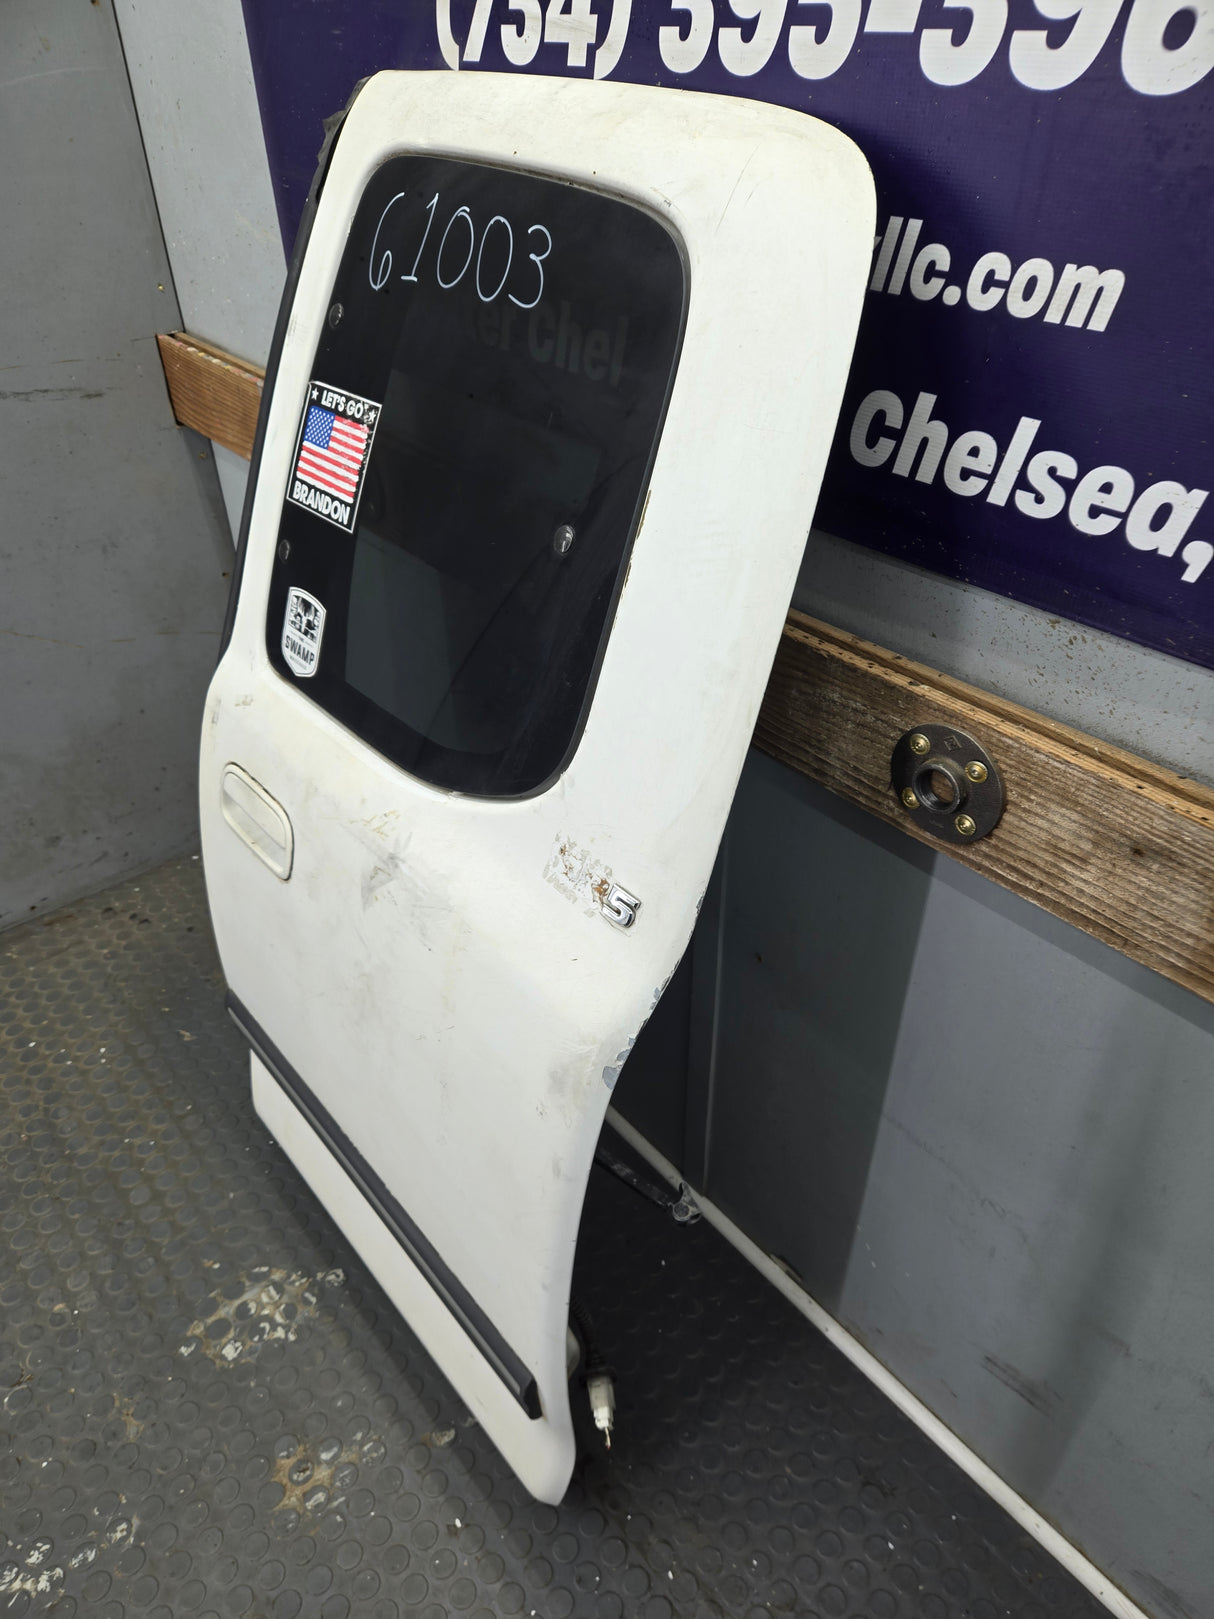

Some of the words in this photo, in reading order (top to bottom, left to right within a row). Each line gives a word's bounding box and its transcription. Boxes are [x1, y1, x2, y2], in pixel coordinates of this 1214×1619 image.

[368, 192, 553, 309] 61003
[869, 215, 1126, 332] llc.com
[320, 389, 346, 412] LET'S
[346, 400, 364, 418] GO
[292, 480, 350, 525] BRANDON
[285, 634, 315, 665] SWAMP
